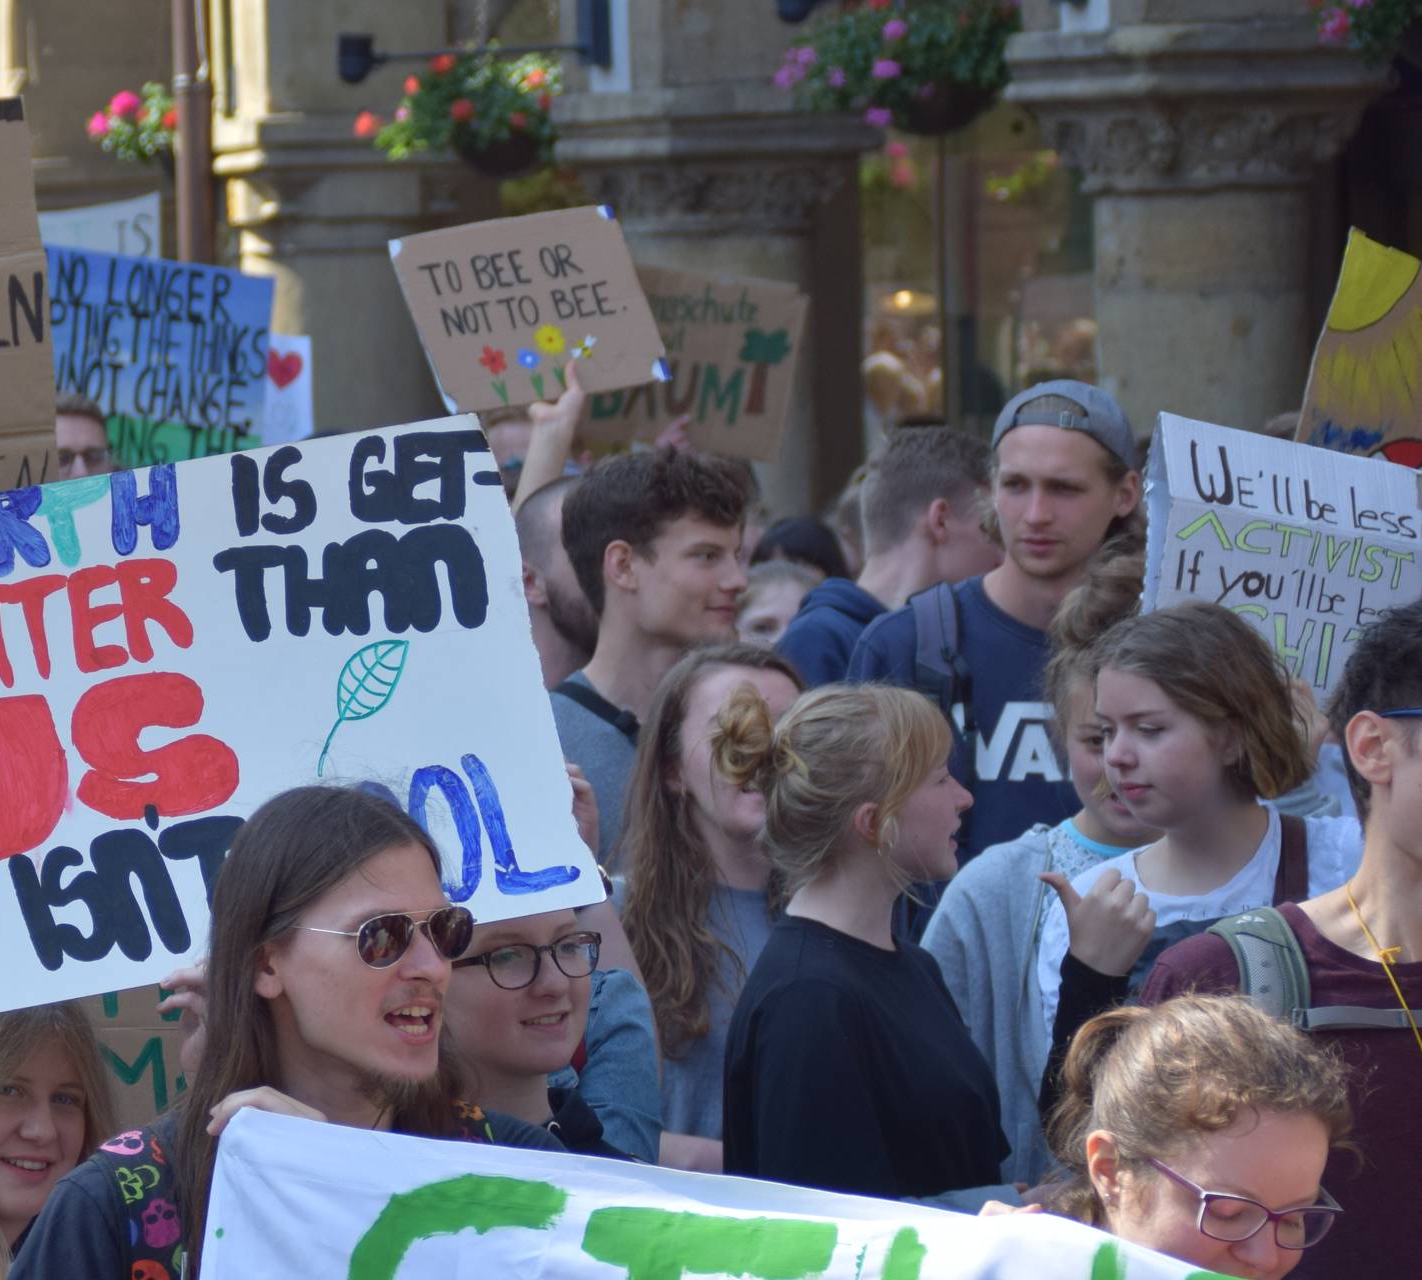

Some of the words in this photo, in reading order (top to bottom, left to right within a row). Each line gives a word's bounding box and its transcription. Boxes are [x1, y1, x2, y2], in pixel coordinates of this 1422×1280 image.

[57, 254, 88, 303] NO
[107, 256, 232, 323] LONGER
[419, 261, 463, 297] TO
[470, 249, 532, 291] BEE
[539, 243, 585, 279] OR
[441, 301, 493, 338] NOT
[494, 296, 540, 331] TO
[550, 280, 628, 321] BEE.
[129, 309, 185, 367] THE
[184, 312, 268, 381] THINGS
[231, 446, 317, 537] IS
[350, 430, 502, 525] GET-
[1304, 479, 1339, 524] be
[1350, 486, 1418, 539] less
[213, 523, 489, 643] THAN
[1175, 549, 1204, 592] If
[1316, 577, 1346, 615] be
[1176, 510, 1415, 590] ACTIVIST
[8, 803, 246, 972] ISN'T
